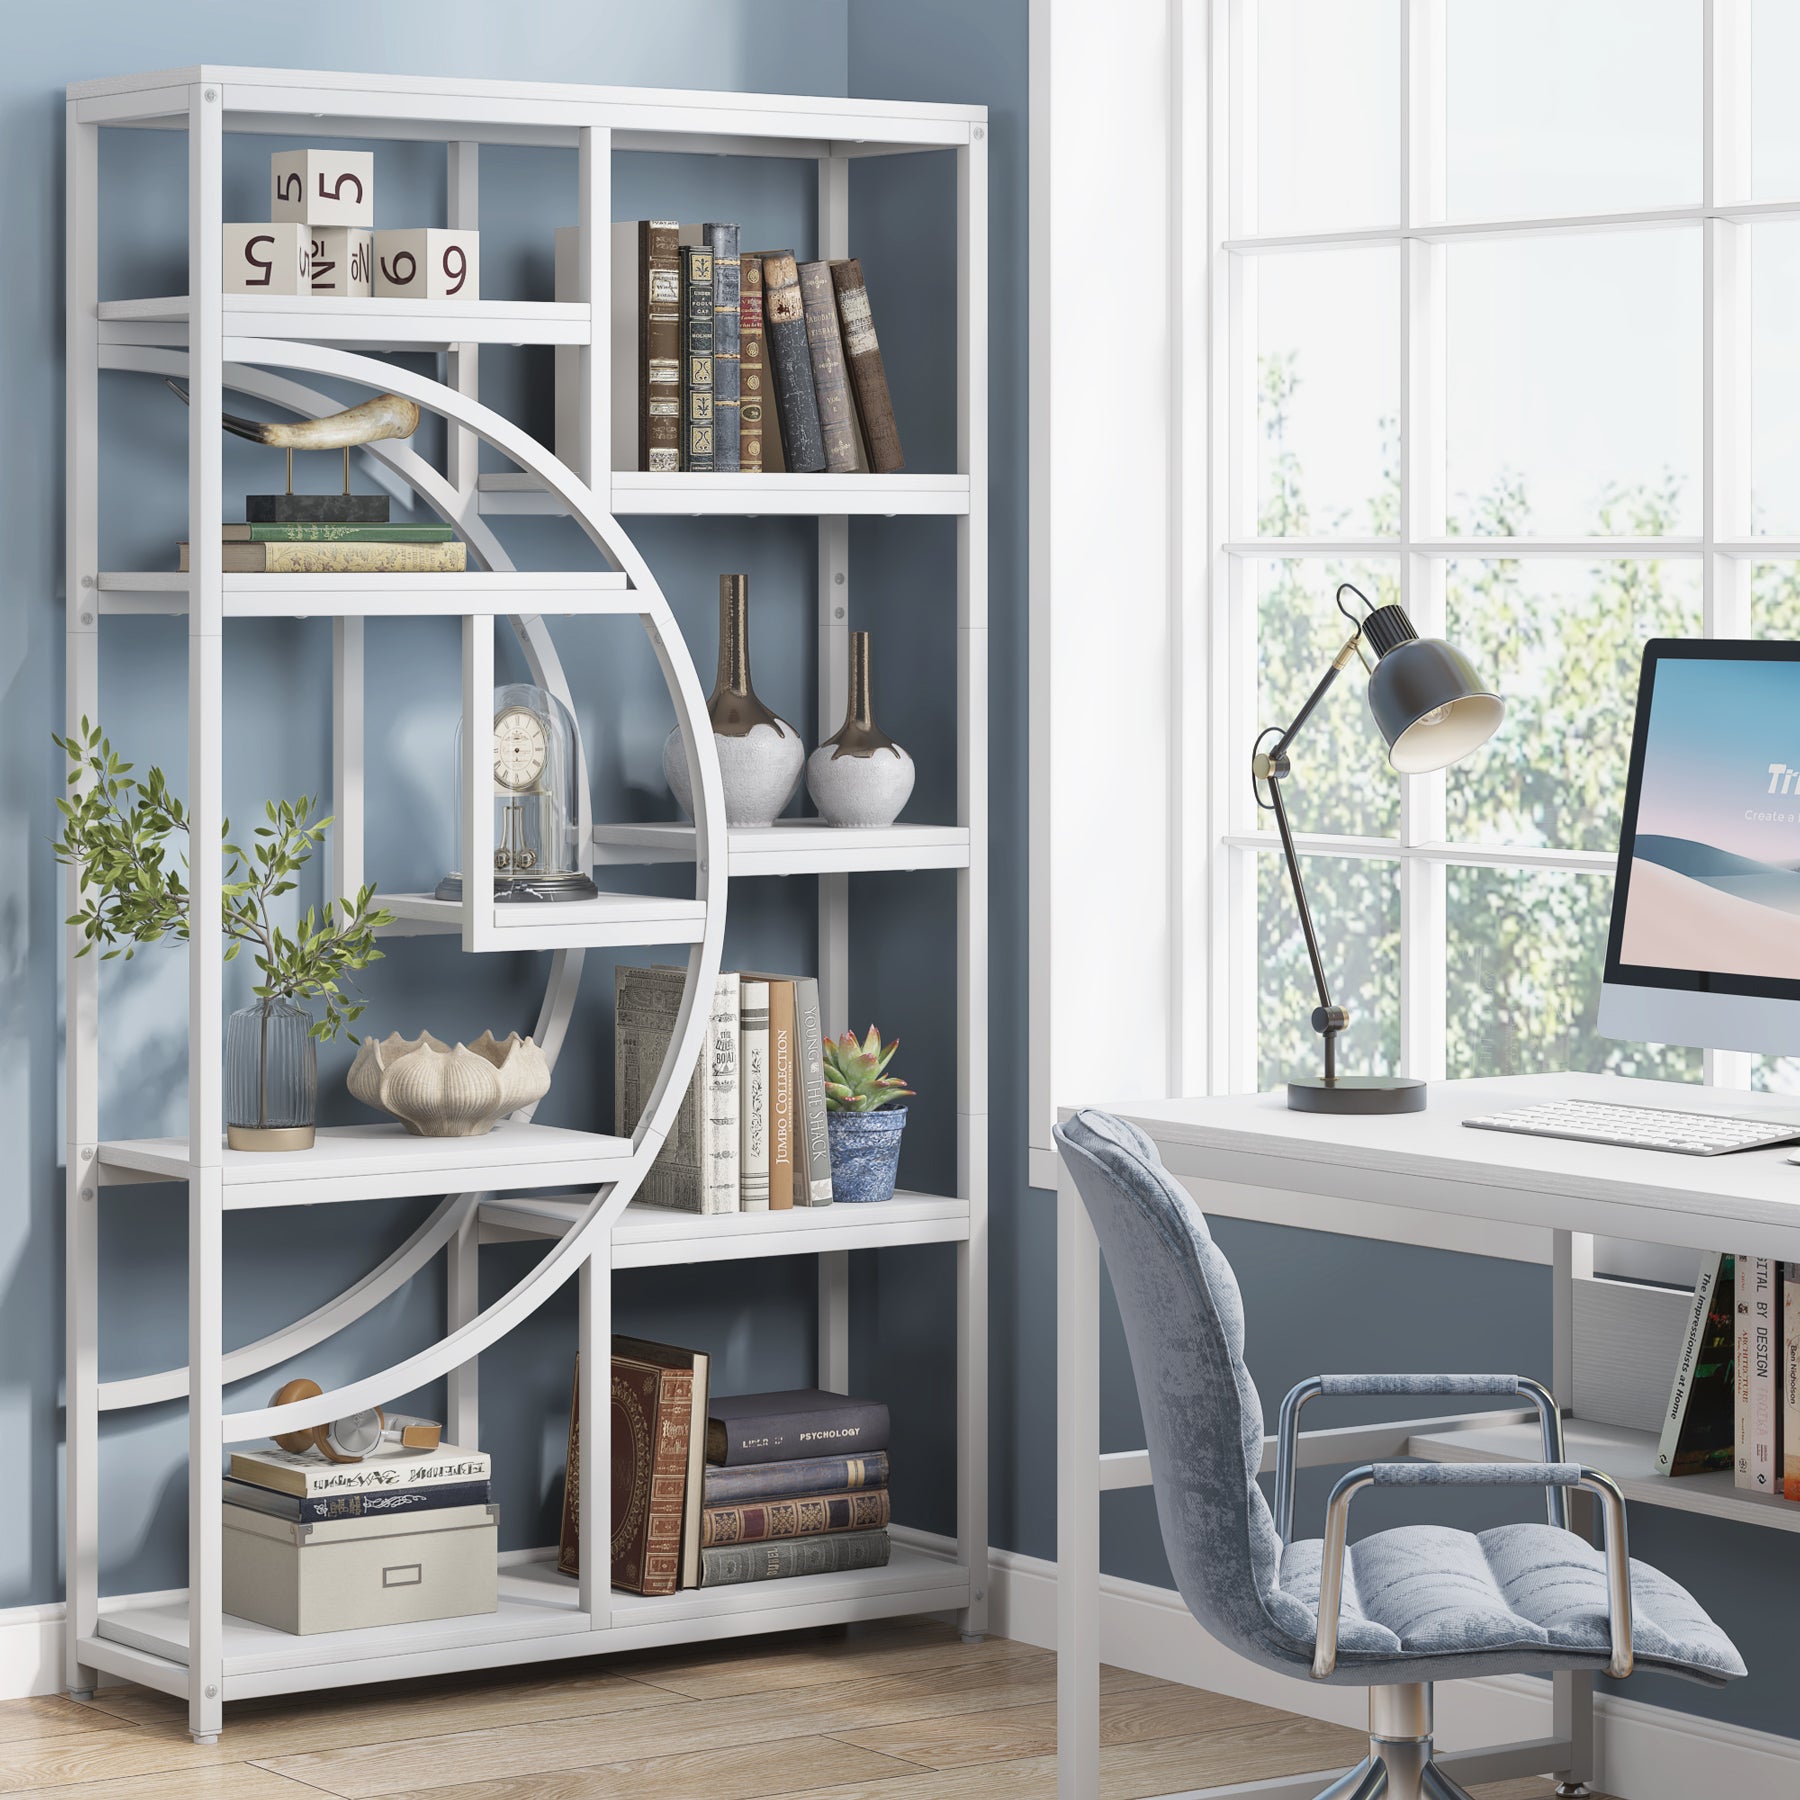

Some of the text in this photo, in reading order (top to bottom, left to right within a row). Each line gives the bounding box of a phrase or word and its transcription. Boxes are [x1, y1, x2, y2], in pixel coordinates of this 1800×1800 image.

[277, 173, 302, 203] 5
[319, 172, 363, 204] 5
[244, 235, 275, 286] 5
[1744, 810, 1794, 823] Create a
[716, 1052, 734, 1064] BOAT
[775, 1030, 790, 1165] JUMBO COLLECTION
[804, 1006, 827, 1162] YOUNG THE SHACK
[1757, 1301, 1768, 1319] BY
[1671, 1272, 1711, 1420] The Impressionists at Home
[1756, 1326, 1768, 1378] DESIGN
[799, 1427, 861, 1441] PSYCHOLOGY
